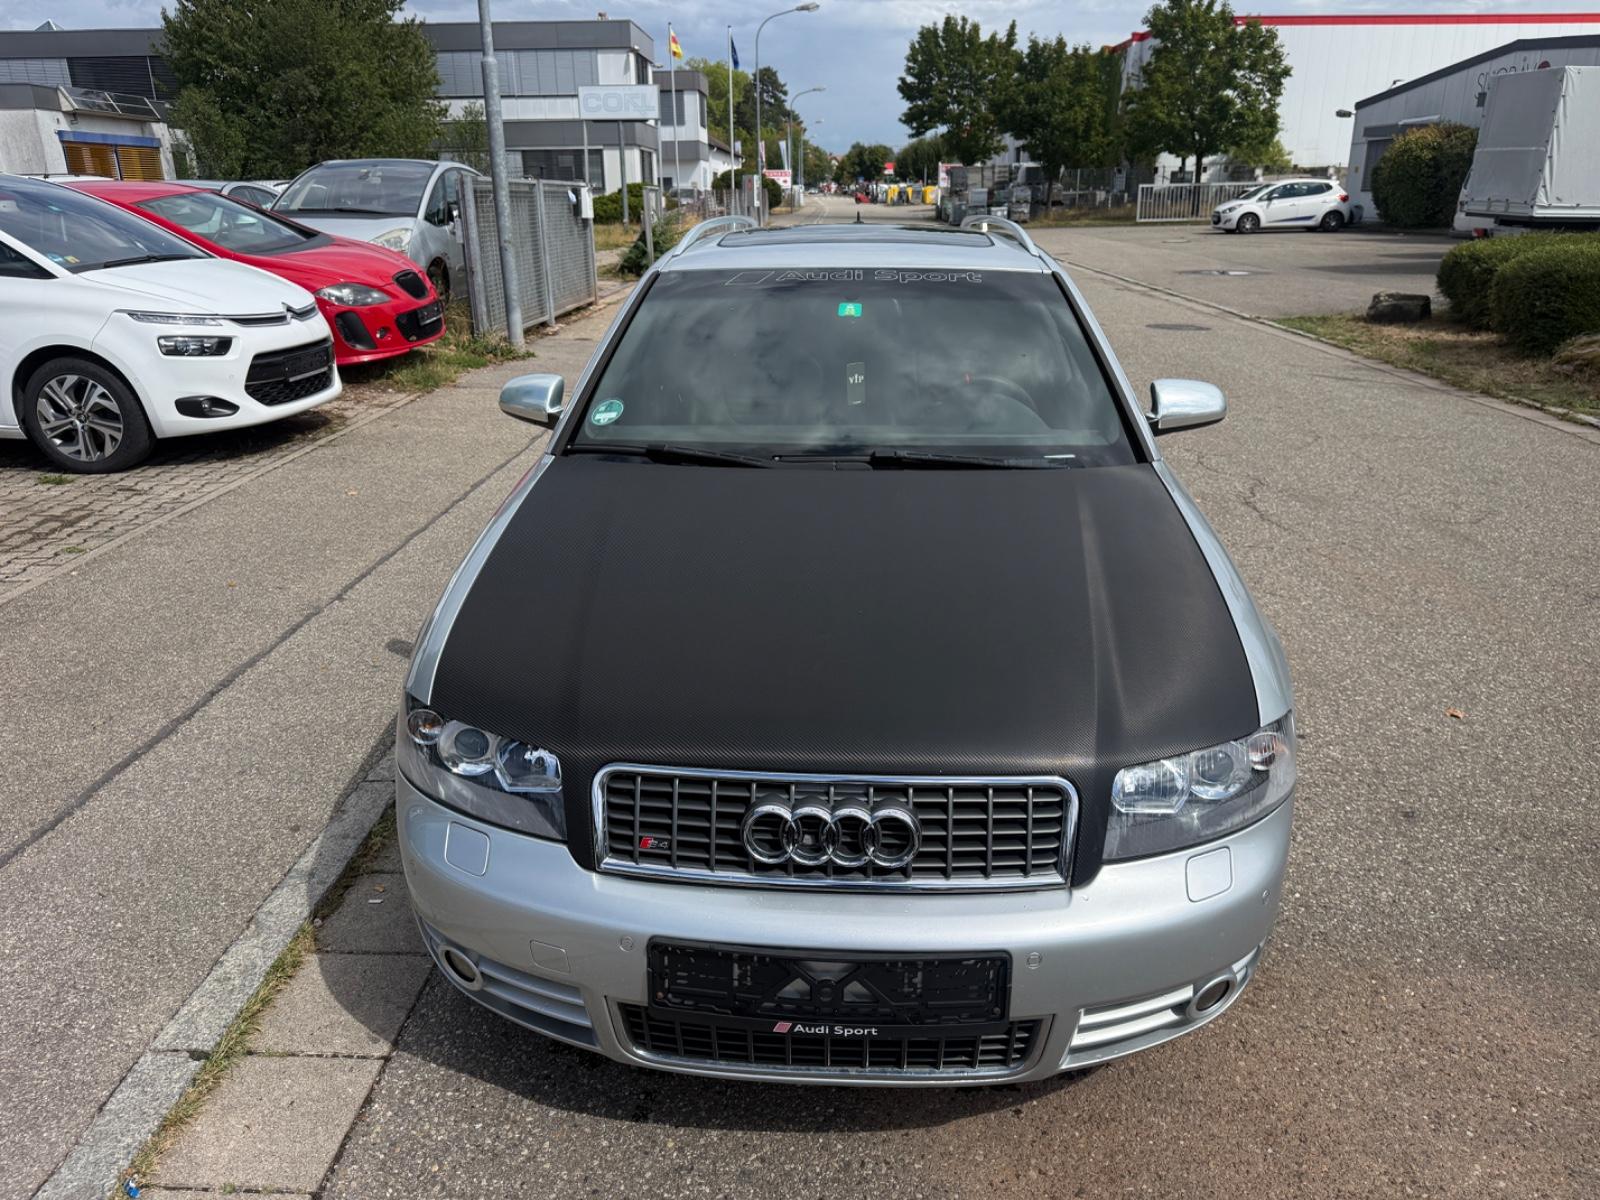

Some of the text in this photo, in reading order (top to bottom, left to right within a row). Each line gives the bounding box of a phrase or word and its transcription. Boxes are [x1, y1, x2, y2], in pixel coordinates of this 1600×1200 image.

[776, 270, 983, 283] Audi Sport
[793, 1024, 878, 1036] Audi Sport
